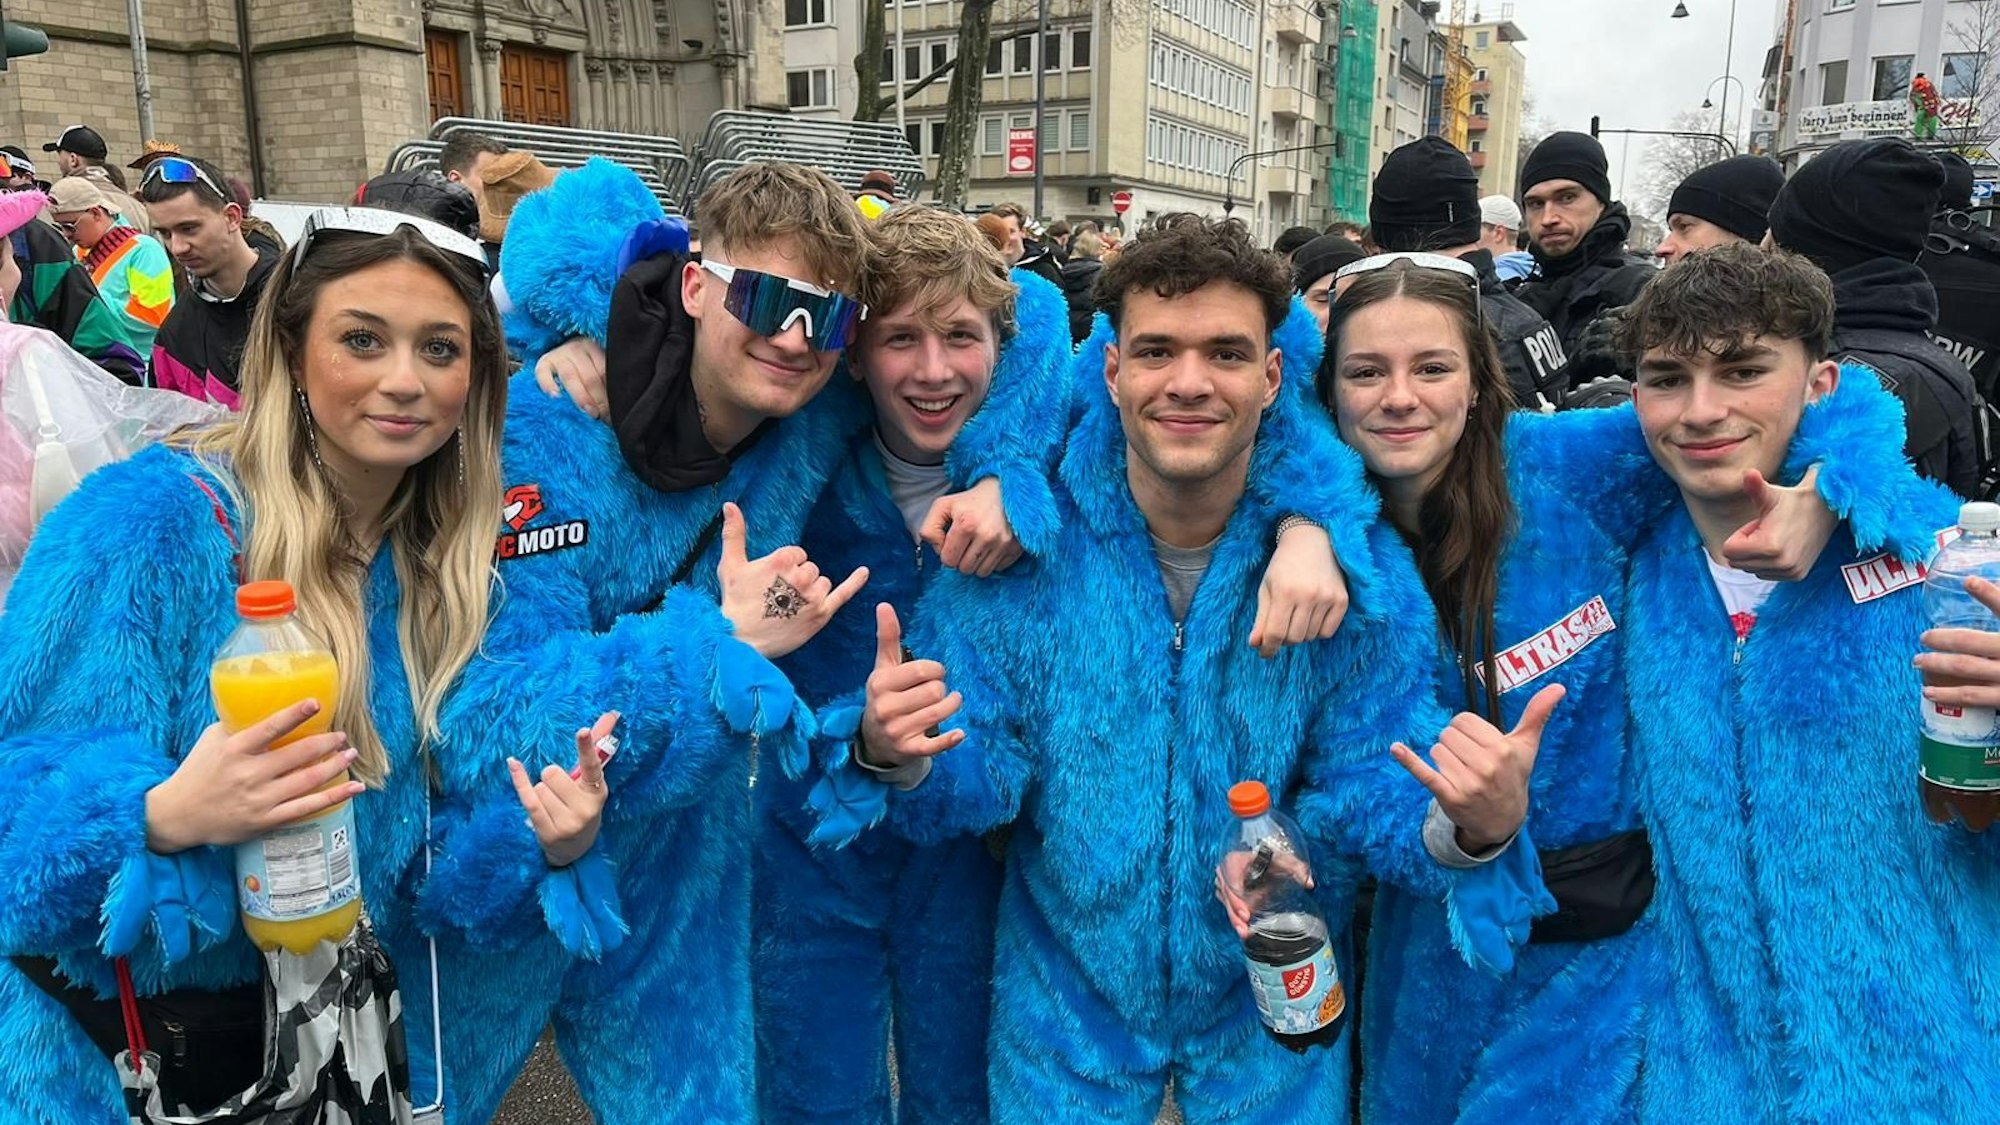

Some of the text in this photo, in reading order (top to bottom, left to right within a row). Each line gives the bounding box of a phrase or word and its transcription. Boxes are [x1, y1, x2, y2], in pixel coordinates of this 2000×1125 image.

[1802, 116, 1827, 128] Party
[1851, 109, 1907, 124] beginnen!
[518, 521, 584, 555] MOTO
